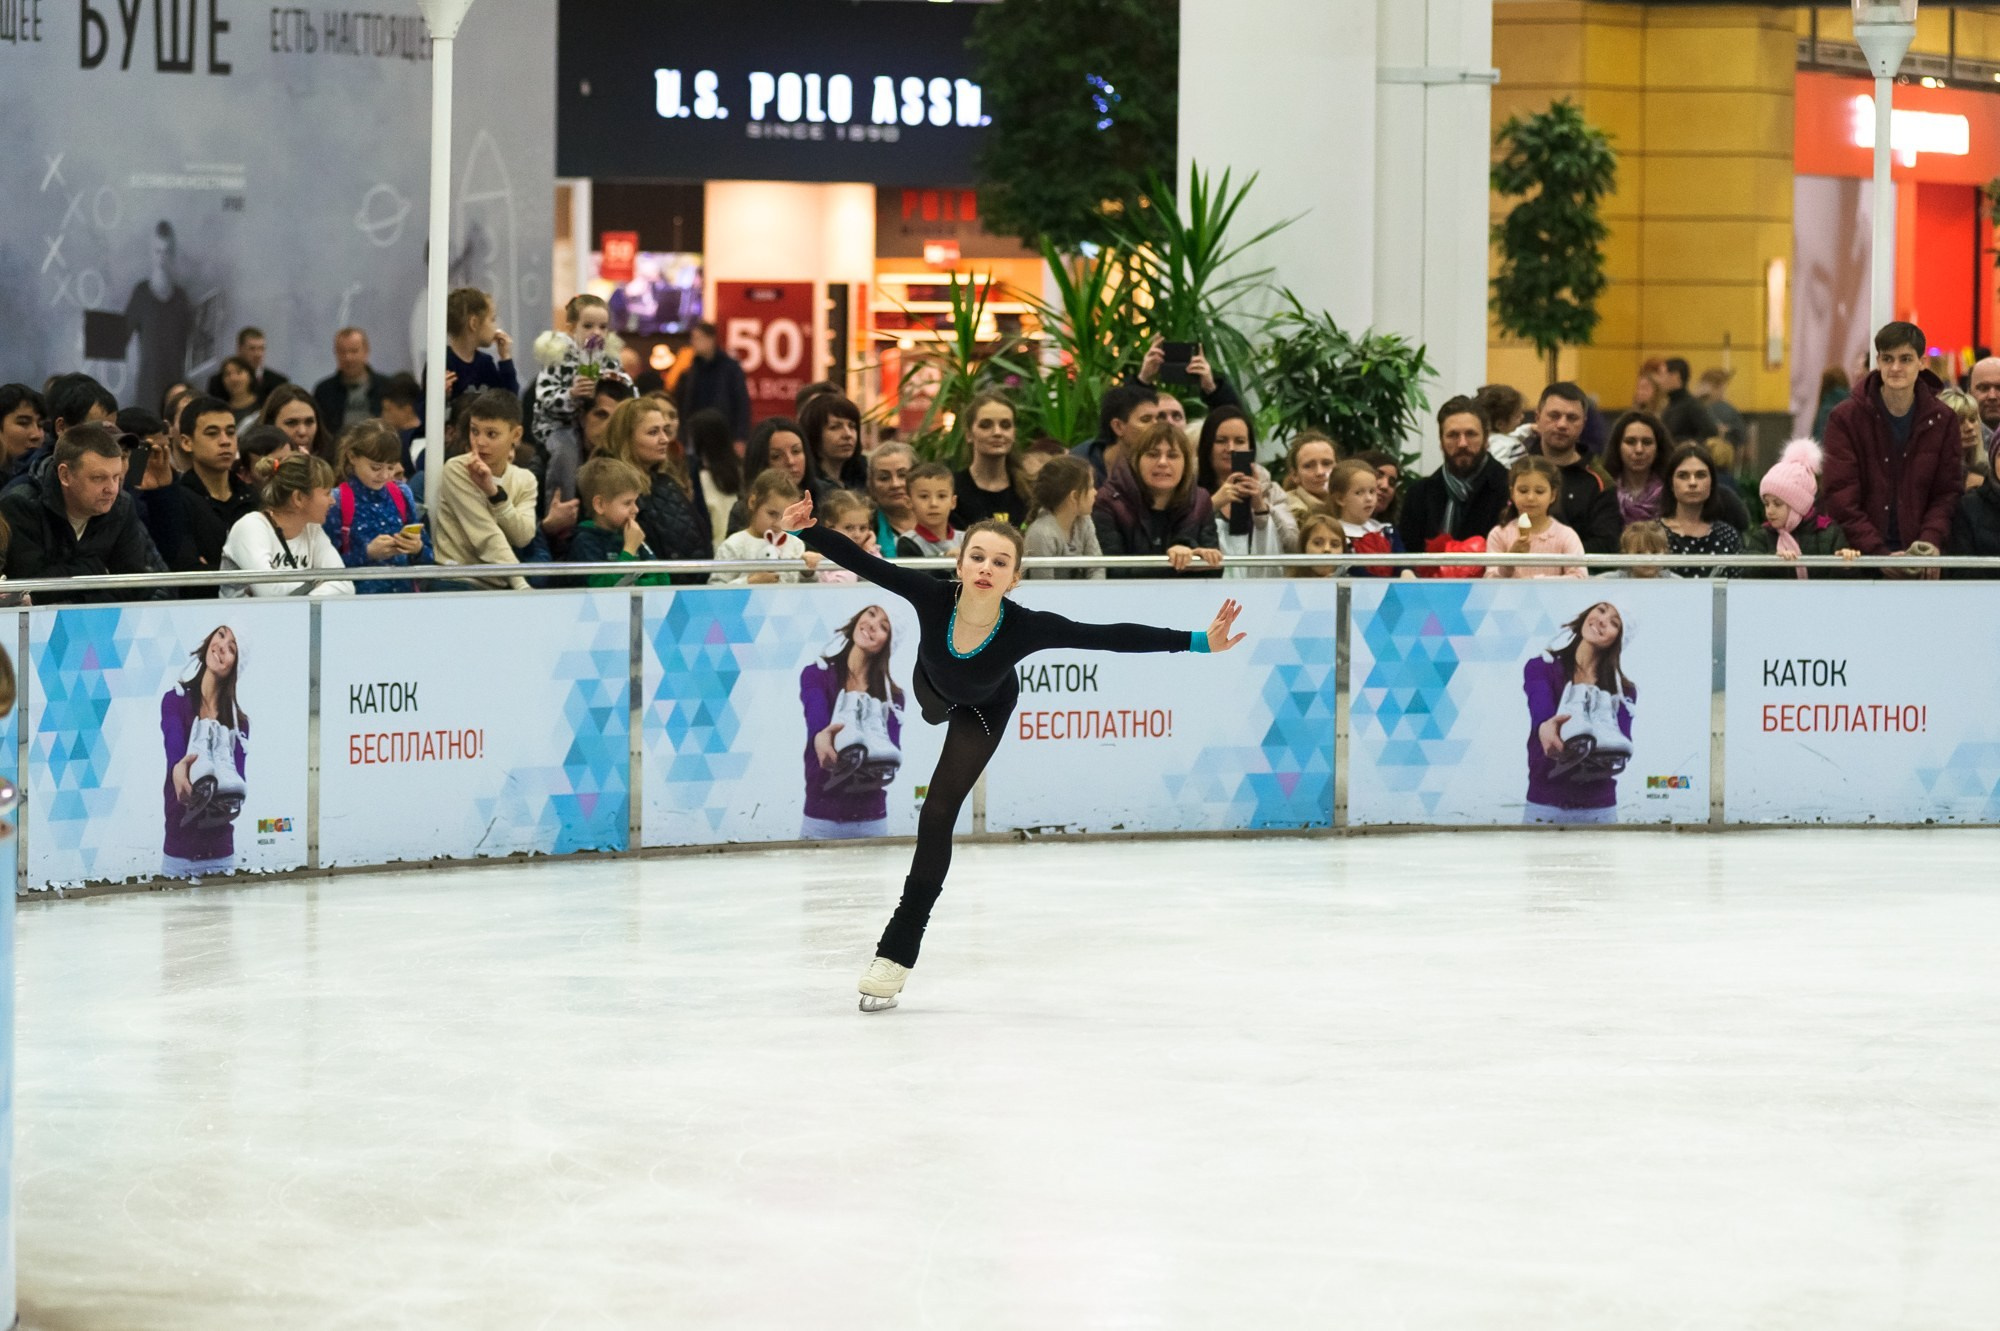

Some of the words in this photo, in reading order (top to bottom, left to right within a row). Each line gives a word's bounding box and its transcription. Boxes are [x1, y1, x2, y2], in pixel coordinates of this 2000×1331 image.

[80, 0, 231, 74] БУШЕ
[271, 8, 318, 53] ЕСТЬ
[324, 12, 432, 64] НАСТОЯЩЕ
[654, 68, 729, 120] U.S.
[748, 71, 853, 124] POLO
[871, 75, 992, 127] ASSN.
[746, 122, 825, 141] SINCE
[1020, 664, 1098, 693] КАТОК
[1763, 659, 1847, 687] КАТОК
[350, 681, 418, 714] КАТОК
[1019, 709, 1173, 741] БЕСПЛАТНО!
[1763, 704, 1927, 732] БЕСПЛАТНО!
[350, 729, 483, 765] БЕСПЛАТНО!
